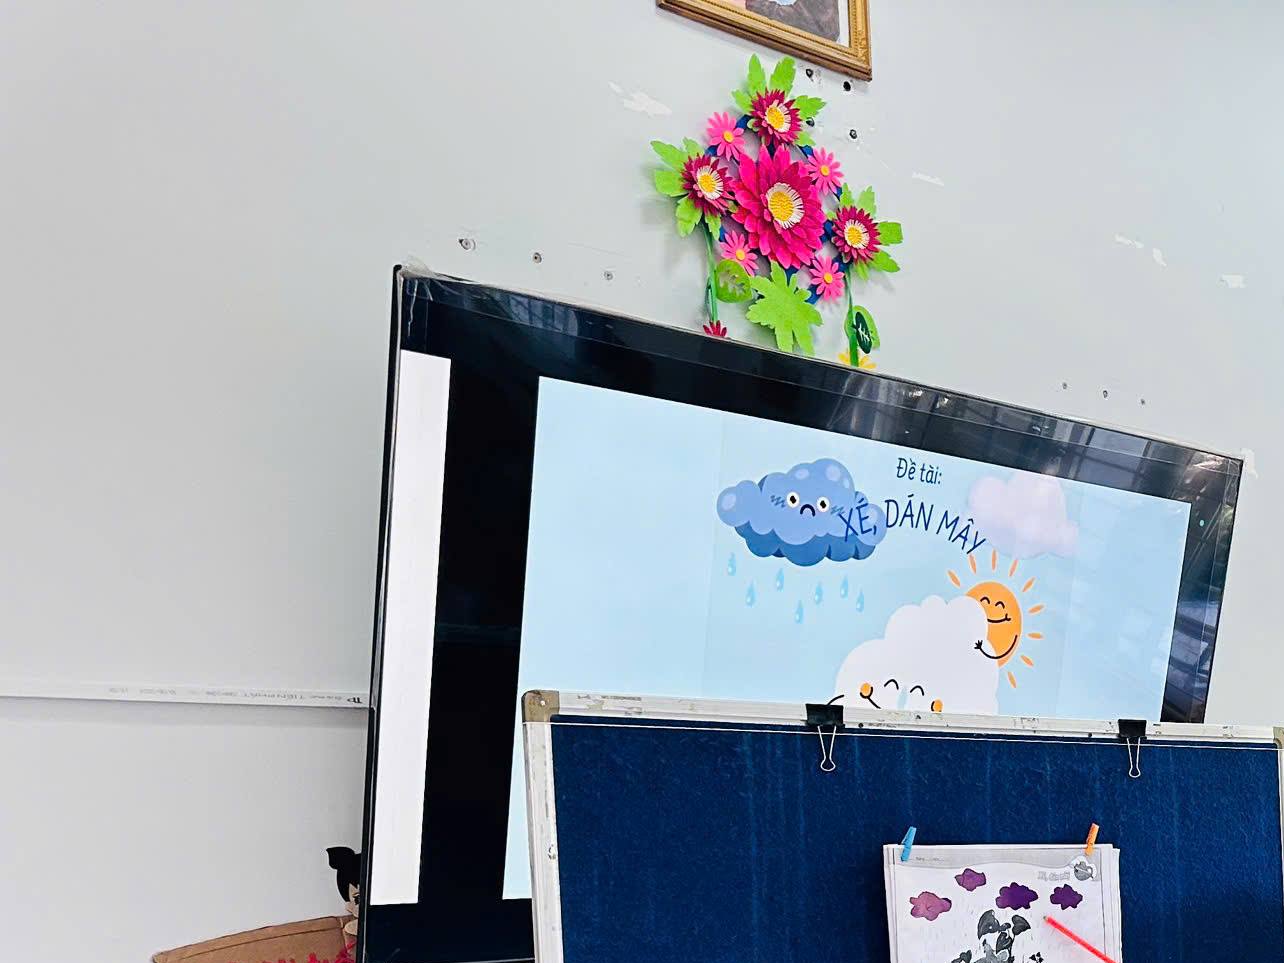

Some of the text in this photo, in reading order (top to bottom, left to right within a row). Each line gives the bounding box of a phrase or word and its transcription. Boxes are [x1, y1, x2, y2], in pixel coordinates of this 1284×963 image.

[896, 457, 943, 485] Đề tài:
[838, 497, 878, 543] XÉ,
[884, 493, 935, 531] DÁN
